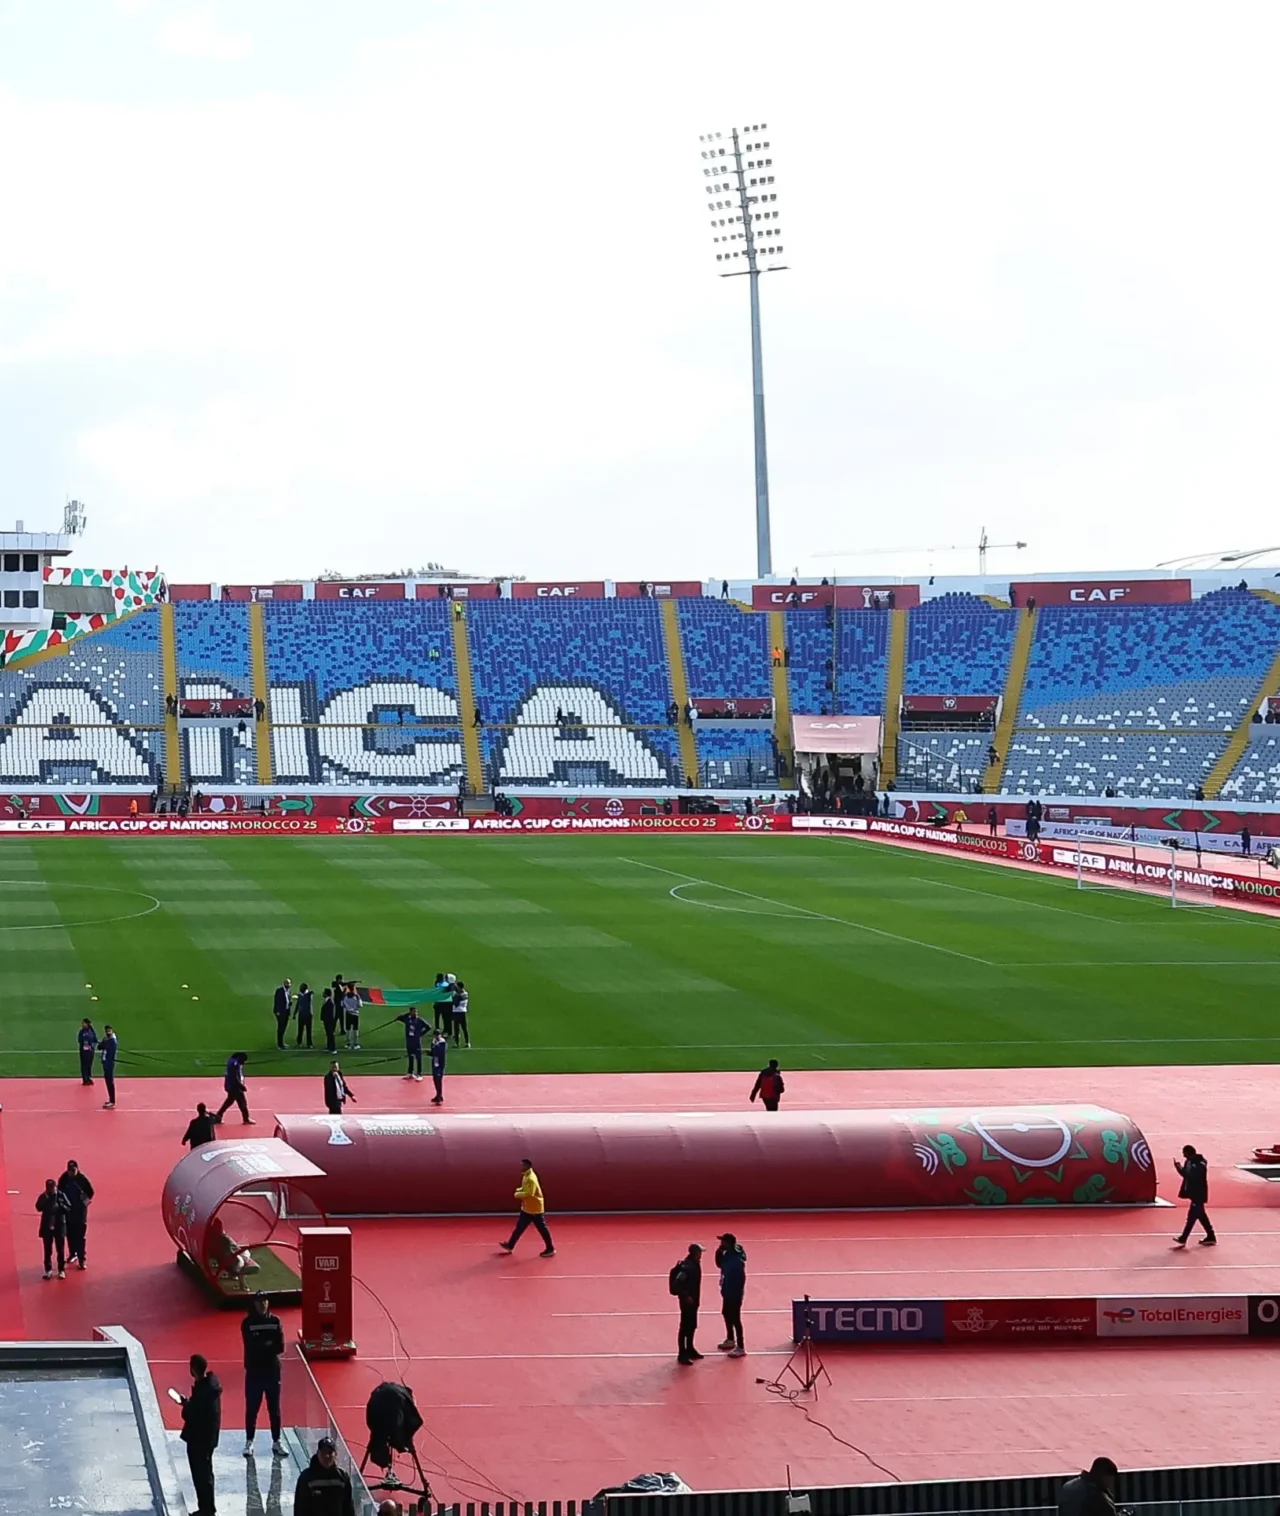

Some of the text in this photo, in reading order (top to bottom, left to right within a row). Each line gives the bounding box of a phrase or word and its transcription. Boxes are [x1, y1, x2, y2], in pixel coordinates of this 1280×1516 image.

[339, 588, 376, 598] CAF
[537, 587, 574, 597] CAF
[1069, 588, 1125, 601] CAF
[210, 702, 221, 710] 23
[70, 820, 317, 830] AFRICA CUP OF NATIONS MOROCCO 25
[422, 820, 461, 828] CAF
[473, 818, 716, 829] AFRICA CUP OF NATIONS MOROCCO 25
[822, 818, 861, 827] CAF
[870, 820, 1007, 851] AFRICA CUP OF NATIONS MOROCCO 25
[1073, 854, 1100, 866] CAF
[1108, 859, 1145, 875] AFRICA
[1145, 865, 1166, 878] CUP
[1167, 868, 1182, 881] OF
[318, 1259, 335, 1267] VAR
[811, 1308, 923, 1331] TECNO
[1138, 1308, 1242, 1324] TotalEnergies
